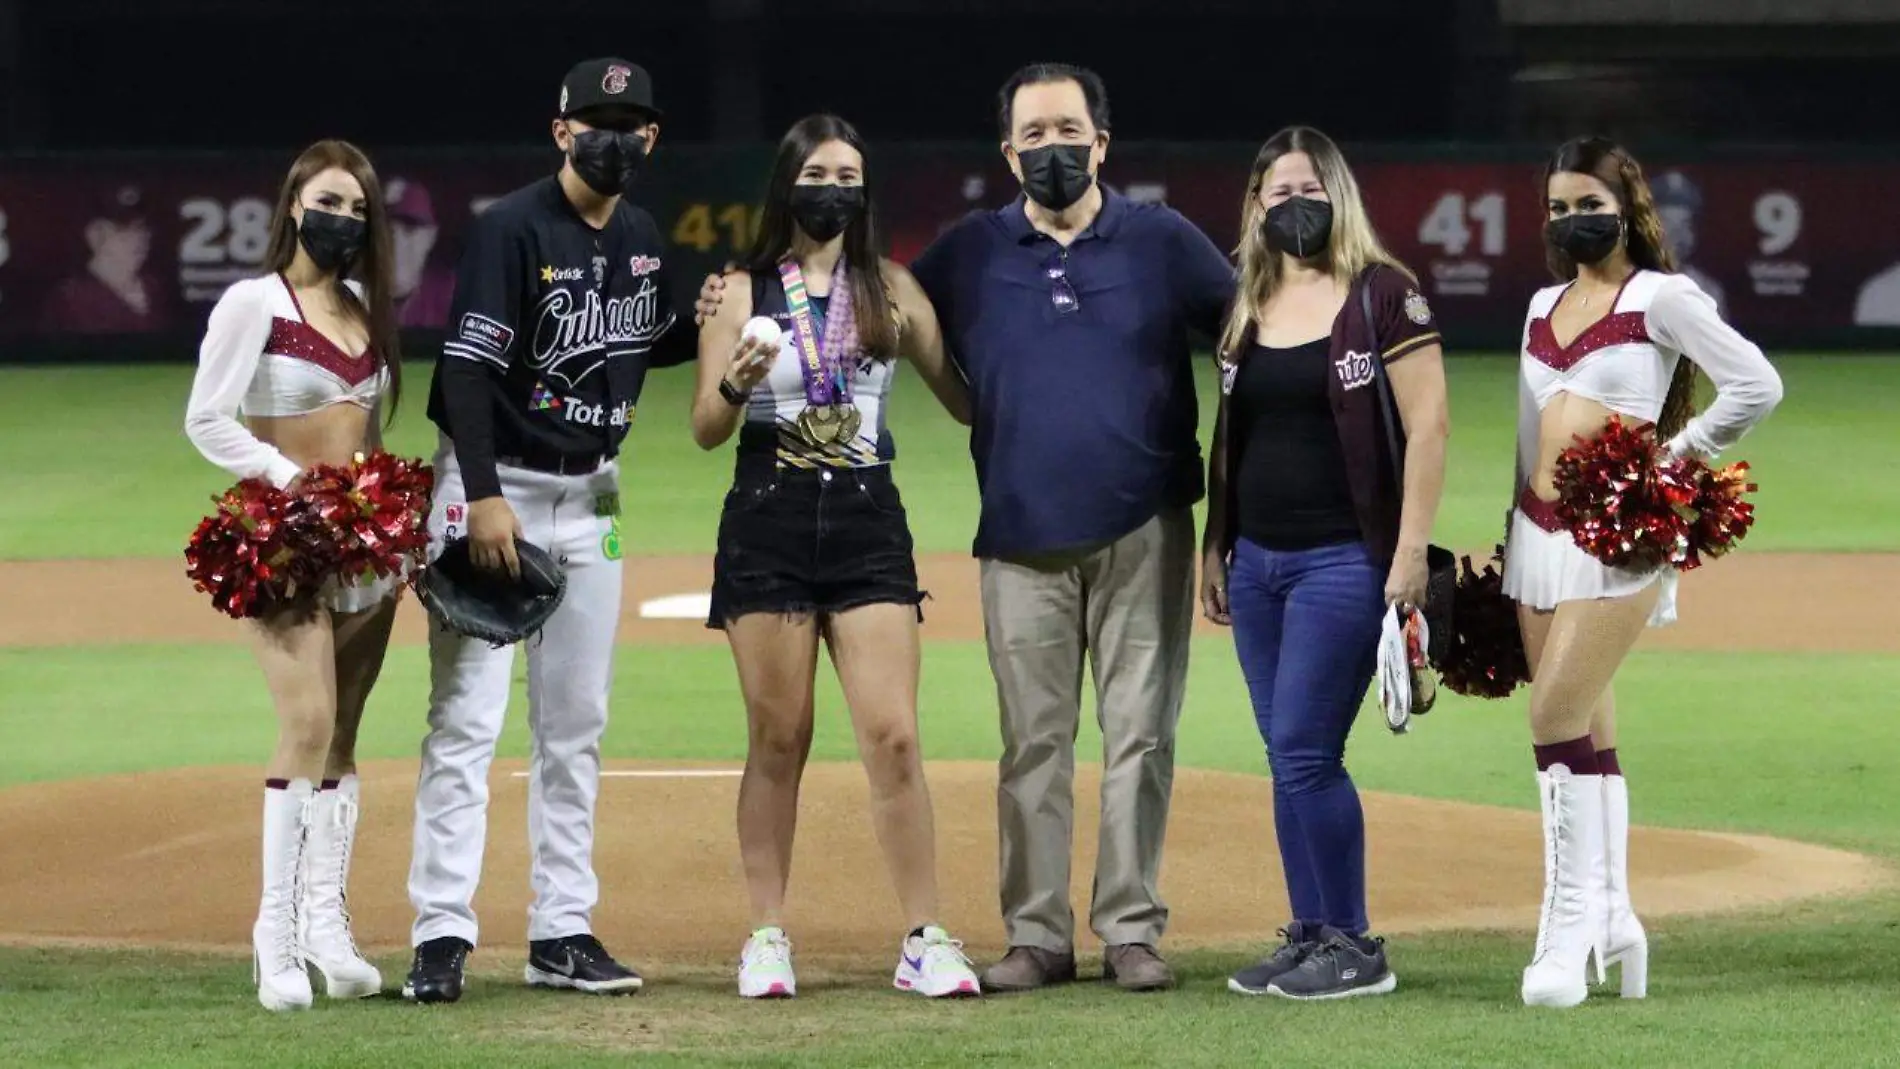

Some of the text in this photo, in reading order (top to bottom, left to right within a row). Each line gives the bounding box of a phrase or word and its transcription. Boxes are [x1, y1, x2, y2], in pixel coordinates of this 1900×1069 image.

[178, 199, 272, 264] 28
[1418, 191, 1506, 256] 41
[1752, 190, 1803, 257] 9
